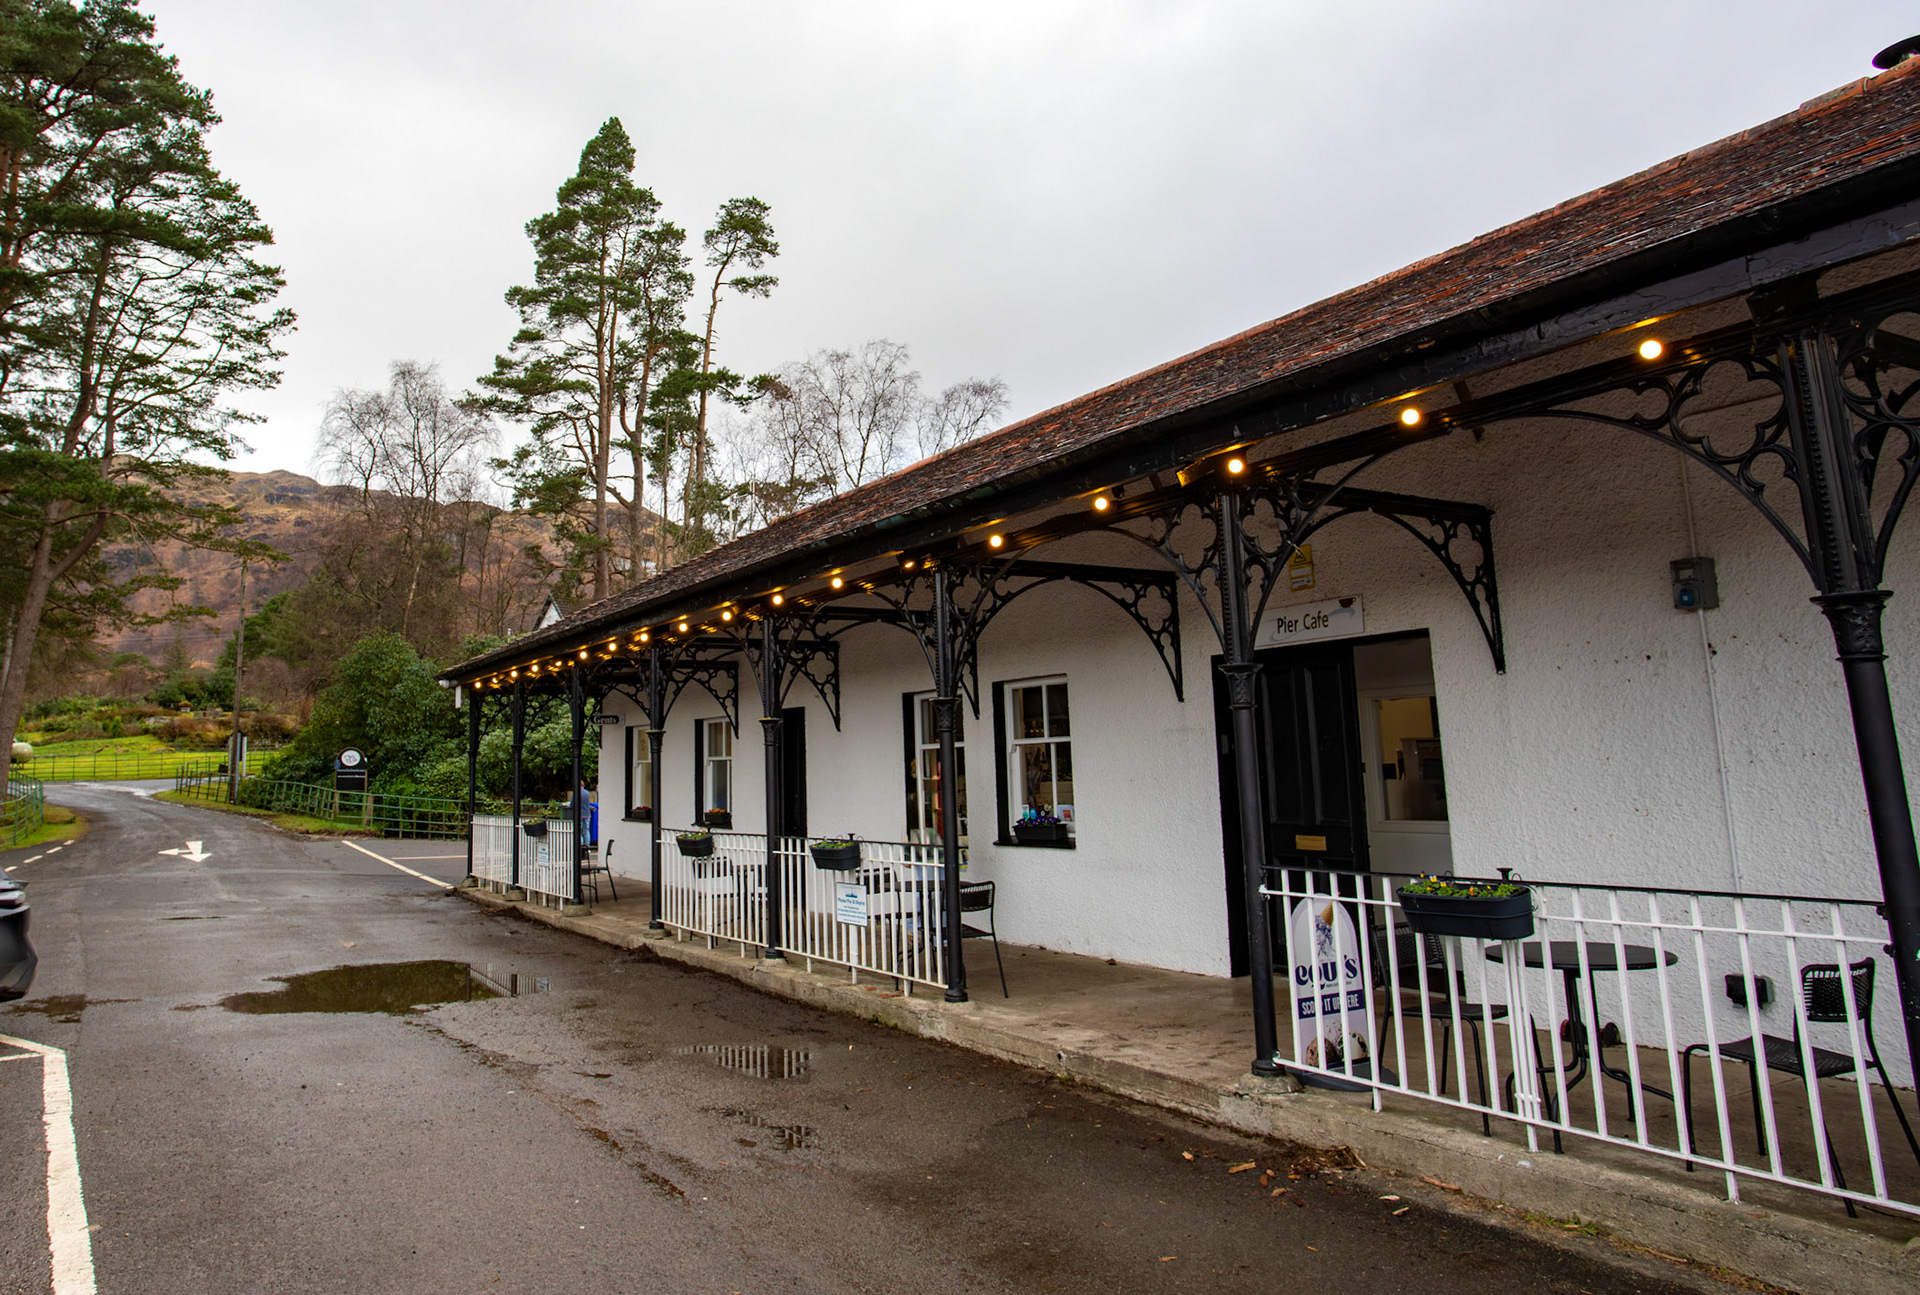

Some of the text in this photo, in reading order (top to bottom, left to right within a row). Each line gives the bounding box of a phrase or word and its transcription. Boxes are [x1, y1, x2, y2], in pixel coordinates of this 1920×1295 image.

[1277, 610, 1329, 634] Pier Cafe
[593, 715, 617, 724] Gents
[1324, 998, 1331, 1012] IT
